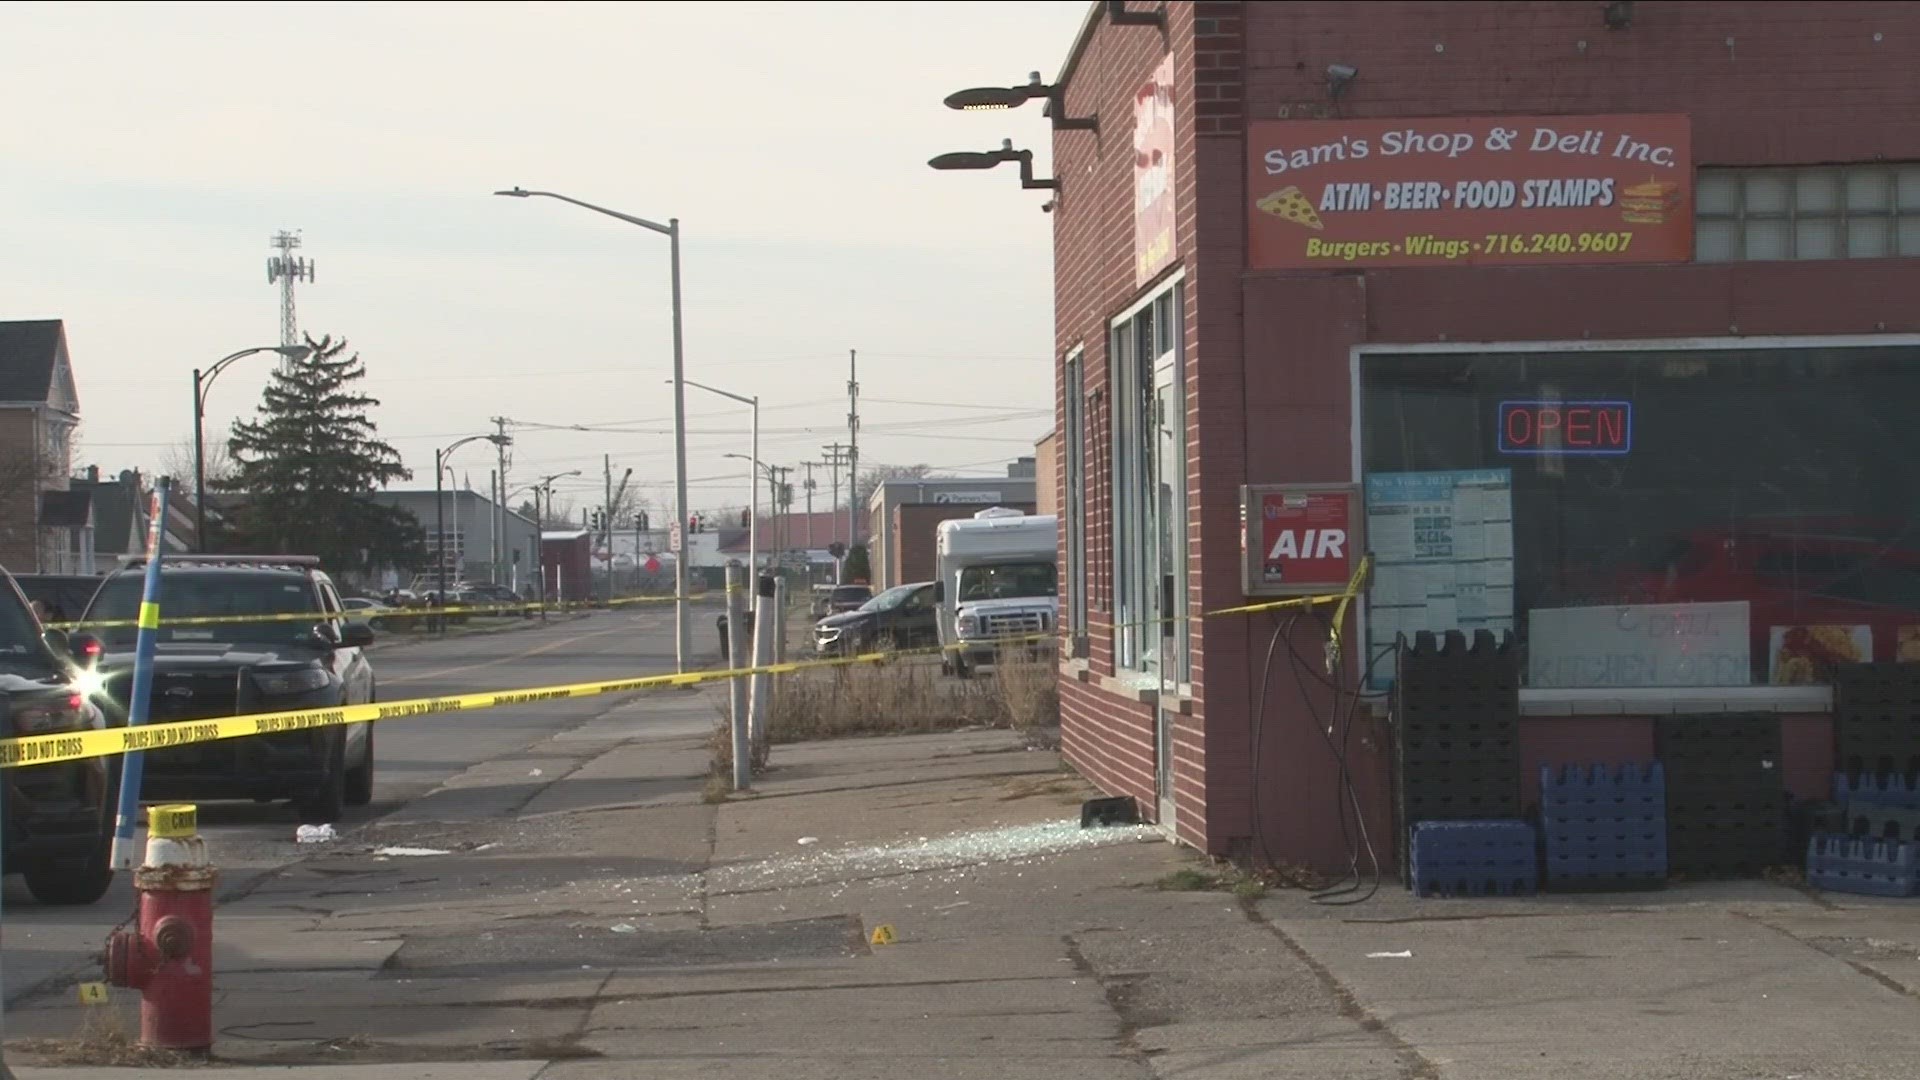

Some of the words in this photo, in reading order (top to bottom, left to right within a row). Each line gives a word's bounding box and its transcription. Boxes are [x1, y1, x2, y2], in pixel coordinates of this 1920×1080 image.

[1264, 136, 1369, 175] Sam's
[1380, 129, 1473, 158] Shop
[1485, 127, 1518, 151] &
[1529, 128, 1604, 155] Deli
[1612, 134, 1675, 167] Inc.
[1319, 183, 1371, 211] ATM
[1384, 181, 1442, 210] BEER
[1454, 180, 1517, 209] FOOD
[1521, 178, 1615, 208] STAMPS
[1306, 238, 1391, 261] Burgers
[1405, 235, 1470, 259] Wings
[1484, 232, 1633, 254] 716.240.9607
[1508, 408, 1624, 446] OPEN
[1268, 528, 1346, 559] AIR
[27, 742, 38, 760] DO
[40, 740, 54, 759] NOT
[57, 737, 83, 757] CROSS
[123, 730, 149, 750] POLICE
[150, 728, 166, 747] LINE
[194, 723, 219, 740] CROSS
[90, 985, 99, 998] 4
